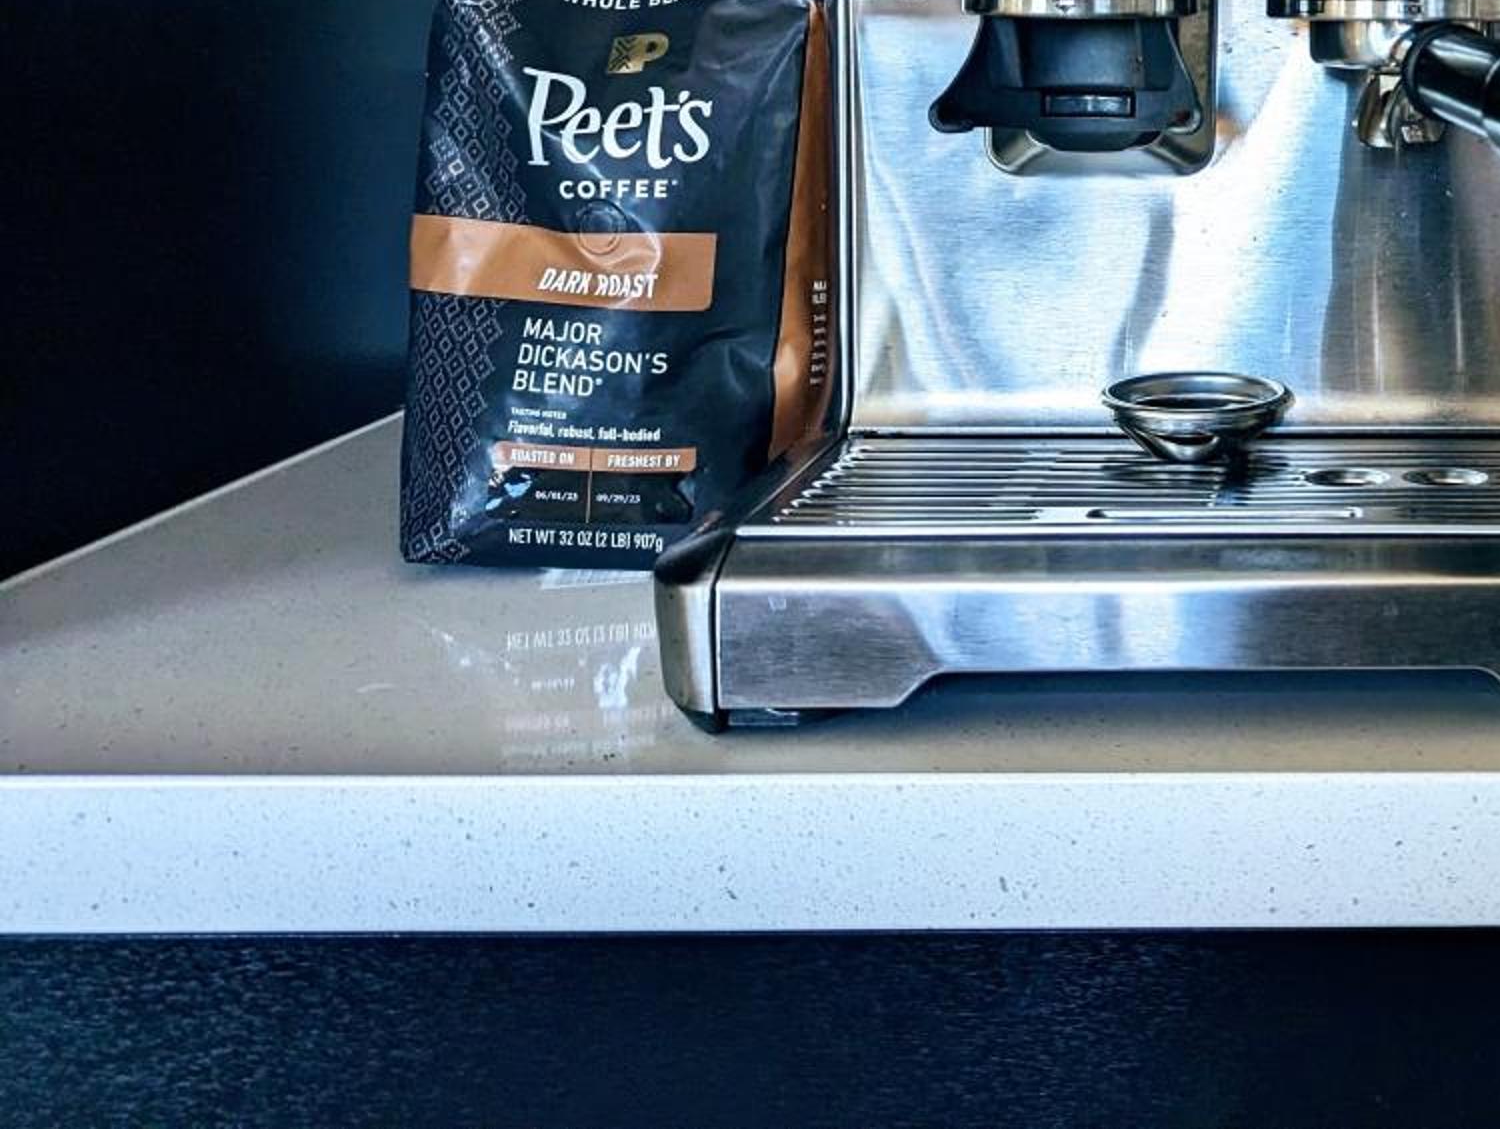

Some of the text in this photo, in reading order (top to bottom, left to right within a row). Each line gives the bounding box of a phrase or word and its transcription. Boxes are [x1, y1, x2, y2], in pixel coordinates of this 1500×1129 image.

[523, 67, 713, 170] Peet's
[559, 178, 669, 200] COFFEE
[538, 268, 659, 299] DARK ROAST
[523, 317, 602, 346] MAJOR
[517, 343, 669, 375] DICKASON'S
[512, 369, 595, 397] BLEND
[508, 420, 661, 442] Flavorful, robust, full-bodied
[511, 448, 575, 464] ROASTED ON
[607, 454, 681, 468] FRESHEST BY
[509, 528, 533, 544] NET
[535, 529, 556, 545] WT
[559, 530, 575, 546] 32
[577, 531, 593, 546] OZ
[633, 533, 664, 553] 907g
